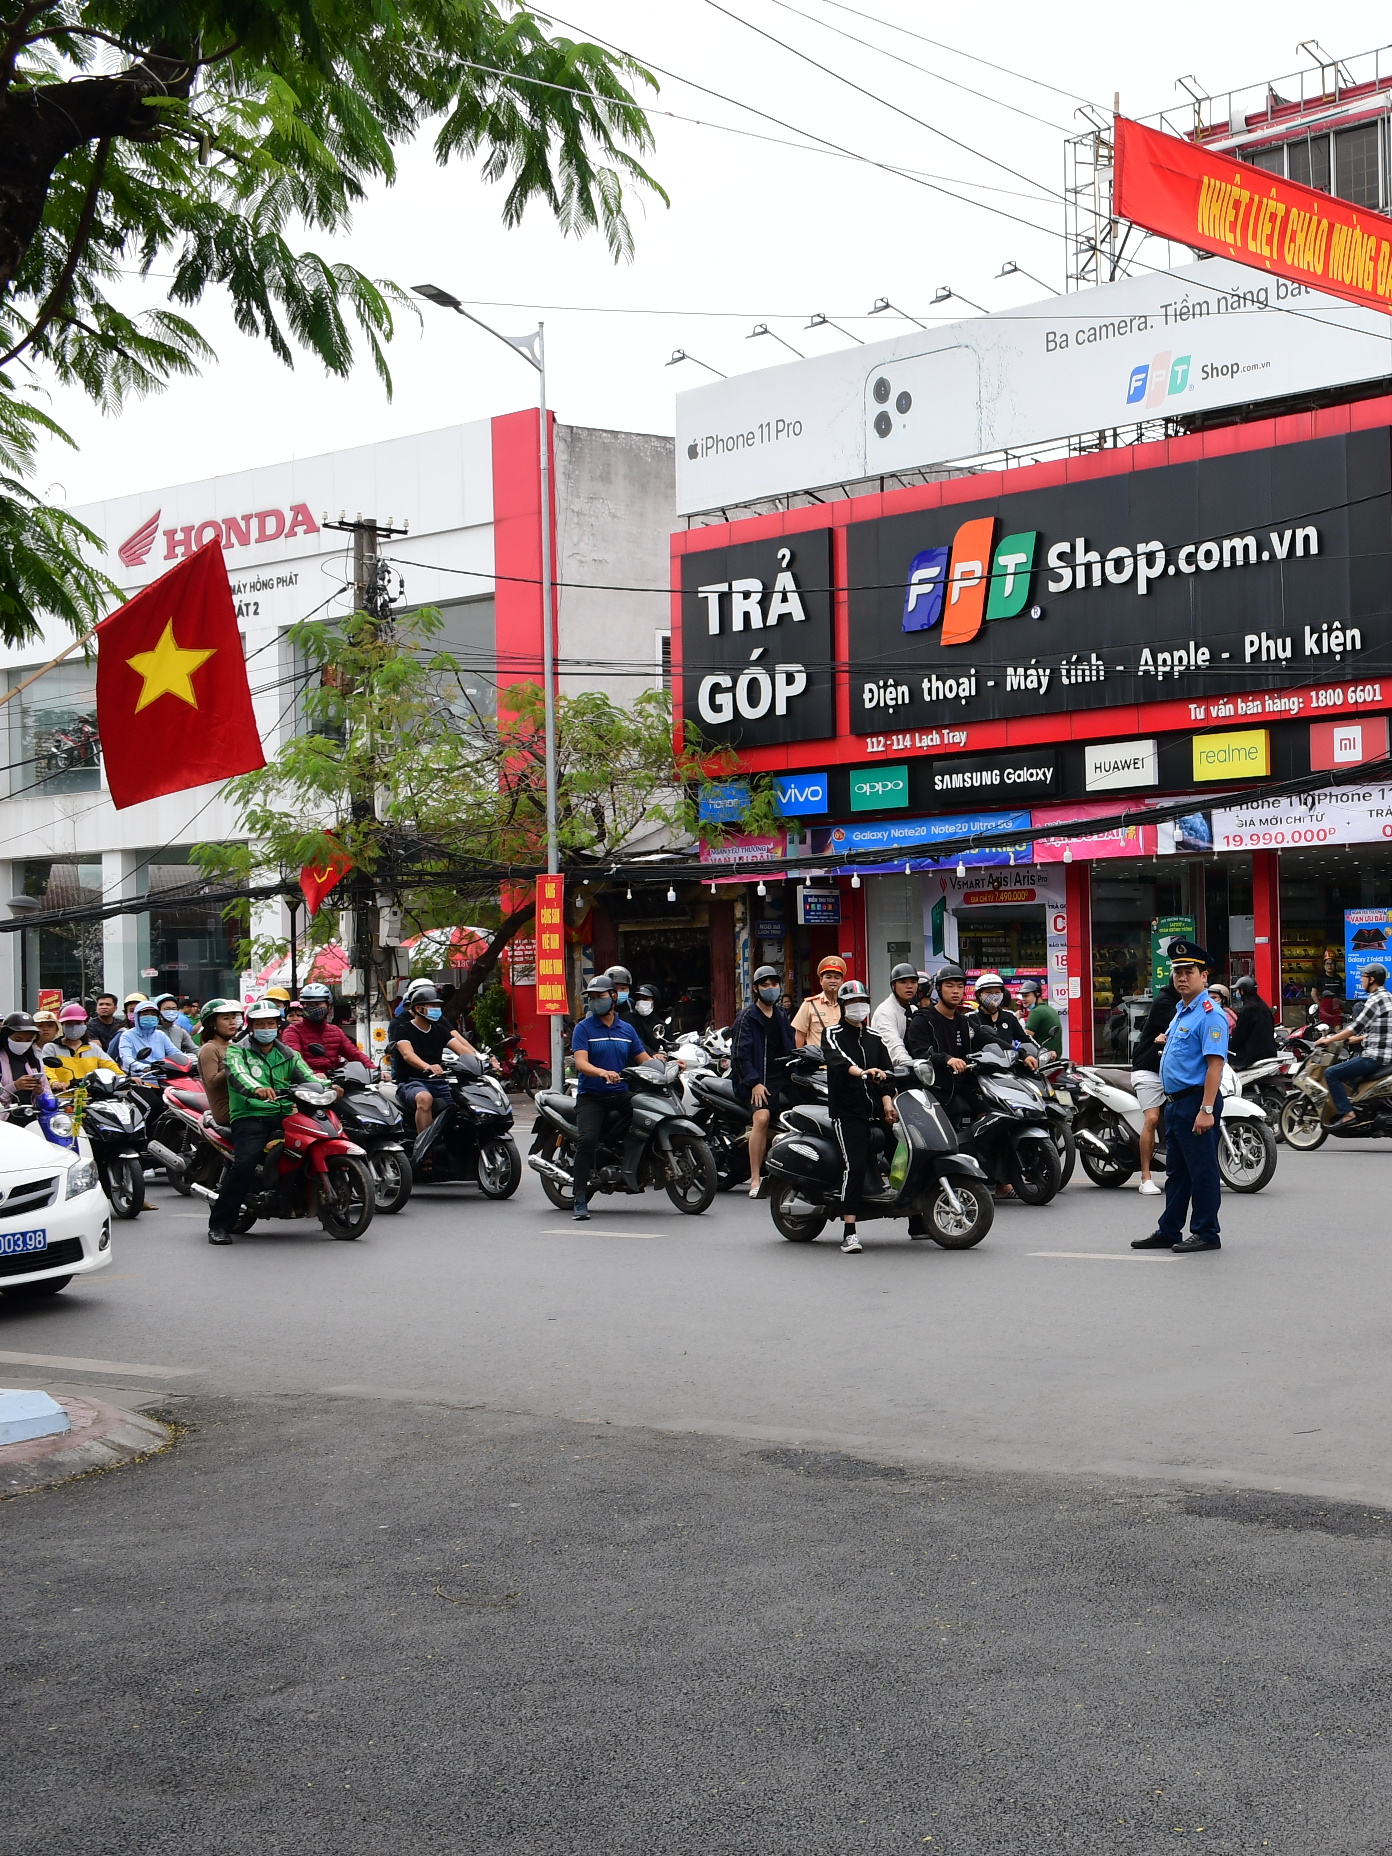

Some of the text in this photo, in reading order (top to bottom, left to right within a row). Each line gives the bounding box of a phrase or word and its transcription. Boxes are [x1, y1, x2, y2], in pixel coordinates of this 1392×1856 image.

[1197, 173, 1251, 256] NHIỆT
[1248, 187, 1286, 268] LIỆT
[1285, 202, 1329, 275] CHÀO
[1329, 214, 1377, 292] MỪNG
[1046, 286, 1269, 353] Ba camera. Tiềm năng
[1127, 352, 1191, 408] FPT
[700, 418, 803, 458] iPhone 11 Pro
[163, 503, 320, 560] HONDA
[249, 571, 300, 594] HỒNG PHÁT
[698, 549, 806, 637] TRẢ
[901, 516, 1320, 646] FPT Shop.com.vn
[252, 601, 260, 616] 2
[863, 624, 1362, 714] Điện thoại Máy tính Apple Phụ kiện
[698, 648, 807, 726] GÓP
[1210, 694, 1235, 718] vấn
[1237, 695, 1262, 716] bán
[1264, 691, 1304, 715] hàng:
[1309, 688, 1343, 710] 1800
[1346, 684, 1383, 705] 6601
[915, 731, 942, 752] Lạch
[943, 728, 968, 750] Tray
[1199, 741, 1260, 767] realme
[934, 766, 1054, 790] SAMSUNG Galaxy
[1094, 757, 1146, 775] HUAWEI
[777, 784, 823, 804] vivo
[853, 830, 889, 841] Galaxy
[891, 826, 927, 838] Note20
[932, 823, 968, 834] Note20
[971, 821, 996, 831] Ultra
[1259, 815, 1283, 827] MỚI
[1309, 811, 1325, 823] TỪ
[987, 872, 1009, 889] Aris
[1014, 870, 1036, 887] Aris
[1038, 875, 1048, 884] Pro
